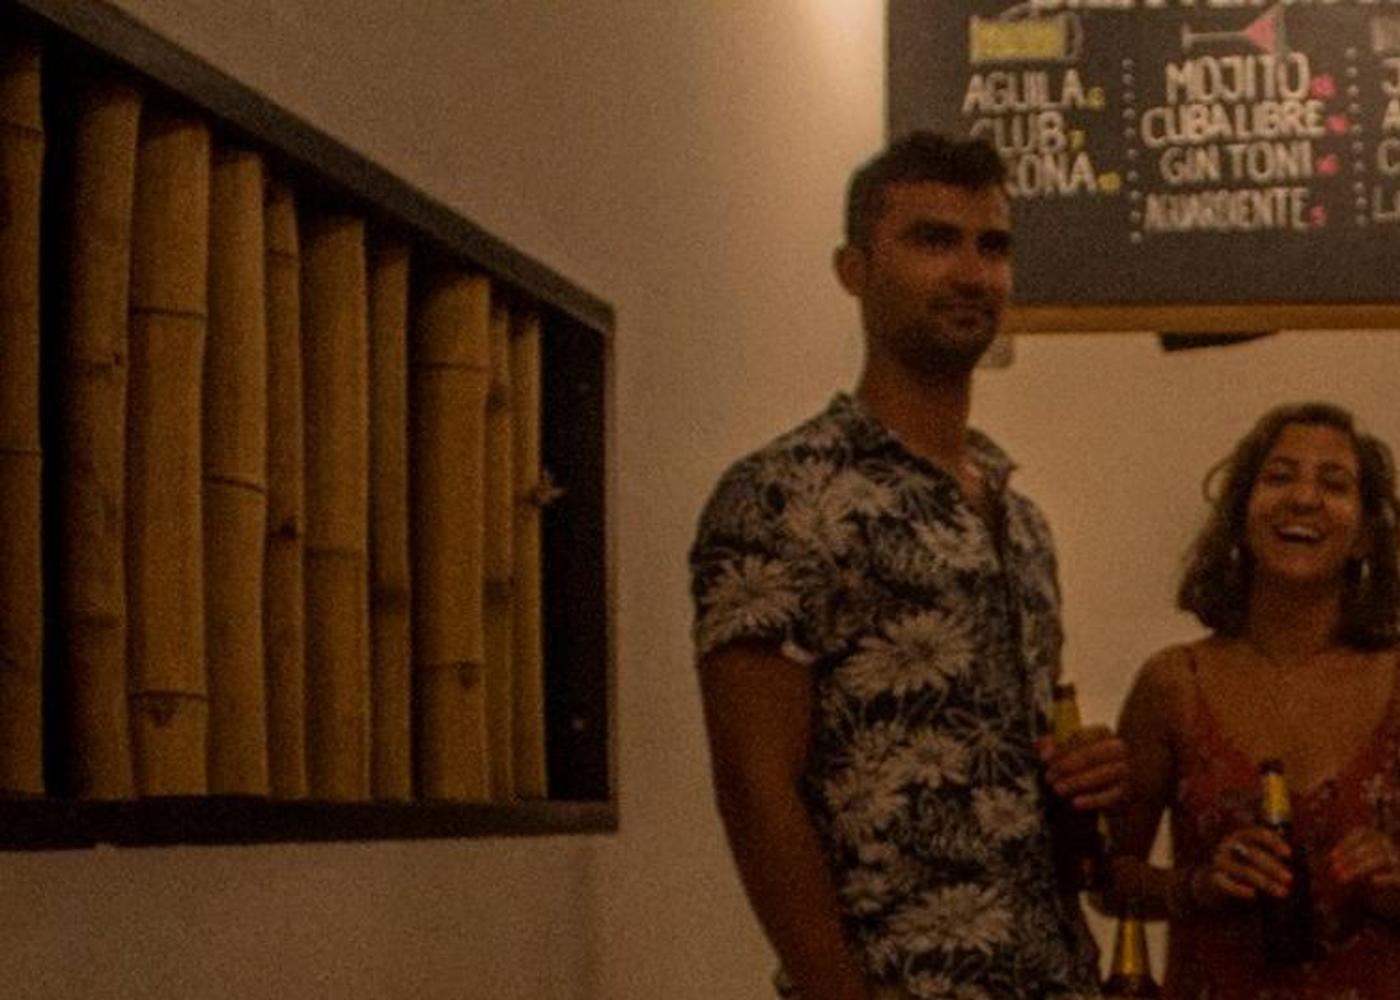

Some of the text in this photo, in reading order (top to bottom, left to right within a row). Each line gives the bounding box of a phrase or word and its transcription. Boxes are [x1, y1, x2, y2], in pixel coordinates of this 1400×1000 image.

[961, 69, 1086, 115] AGUILA
[1165, 52, 1310, 103] MOJITO
[969, 111, 1067, 157] CLUB
[1141, 104, 1233, 148] CUBA
[1235, 100, 1326, 138] LIBRE
[1159, 145, 1221, 185] GIN
[1225, 140, 1312, 182] TONI
